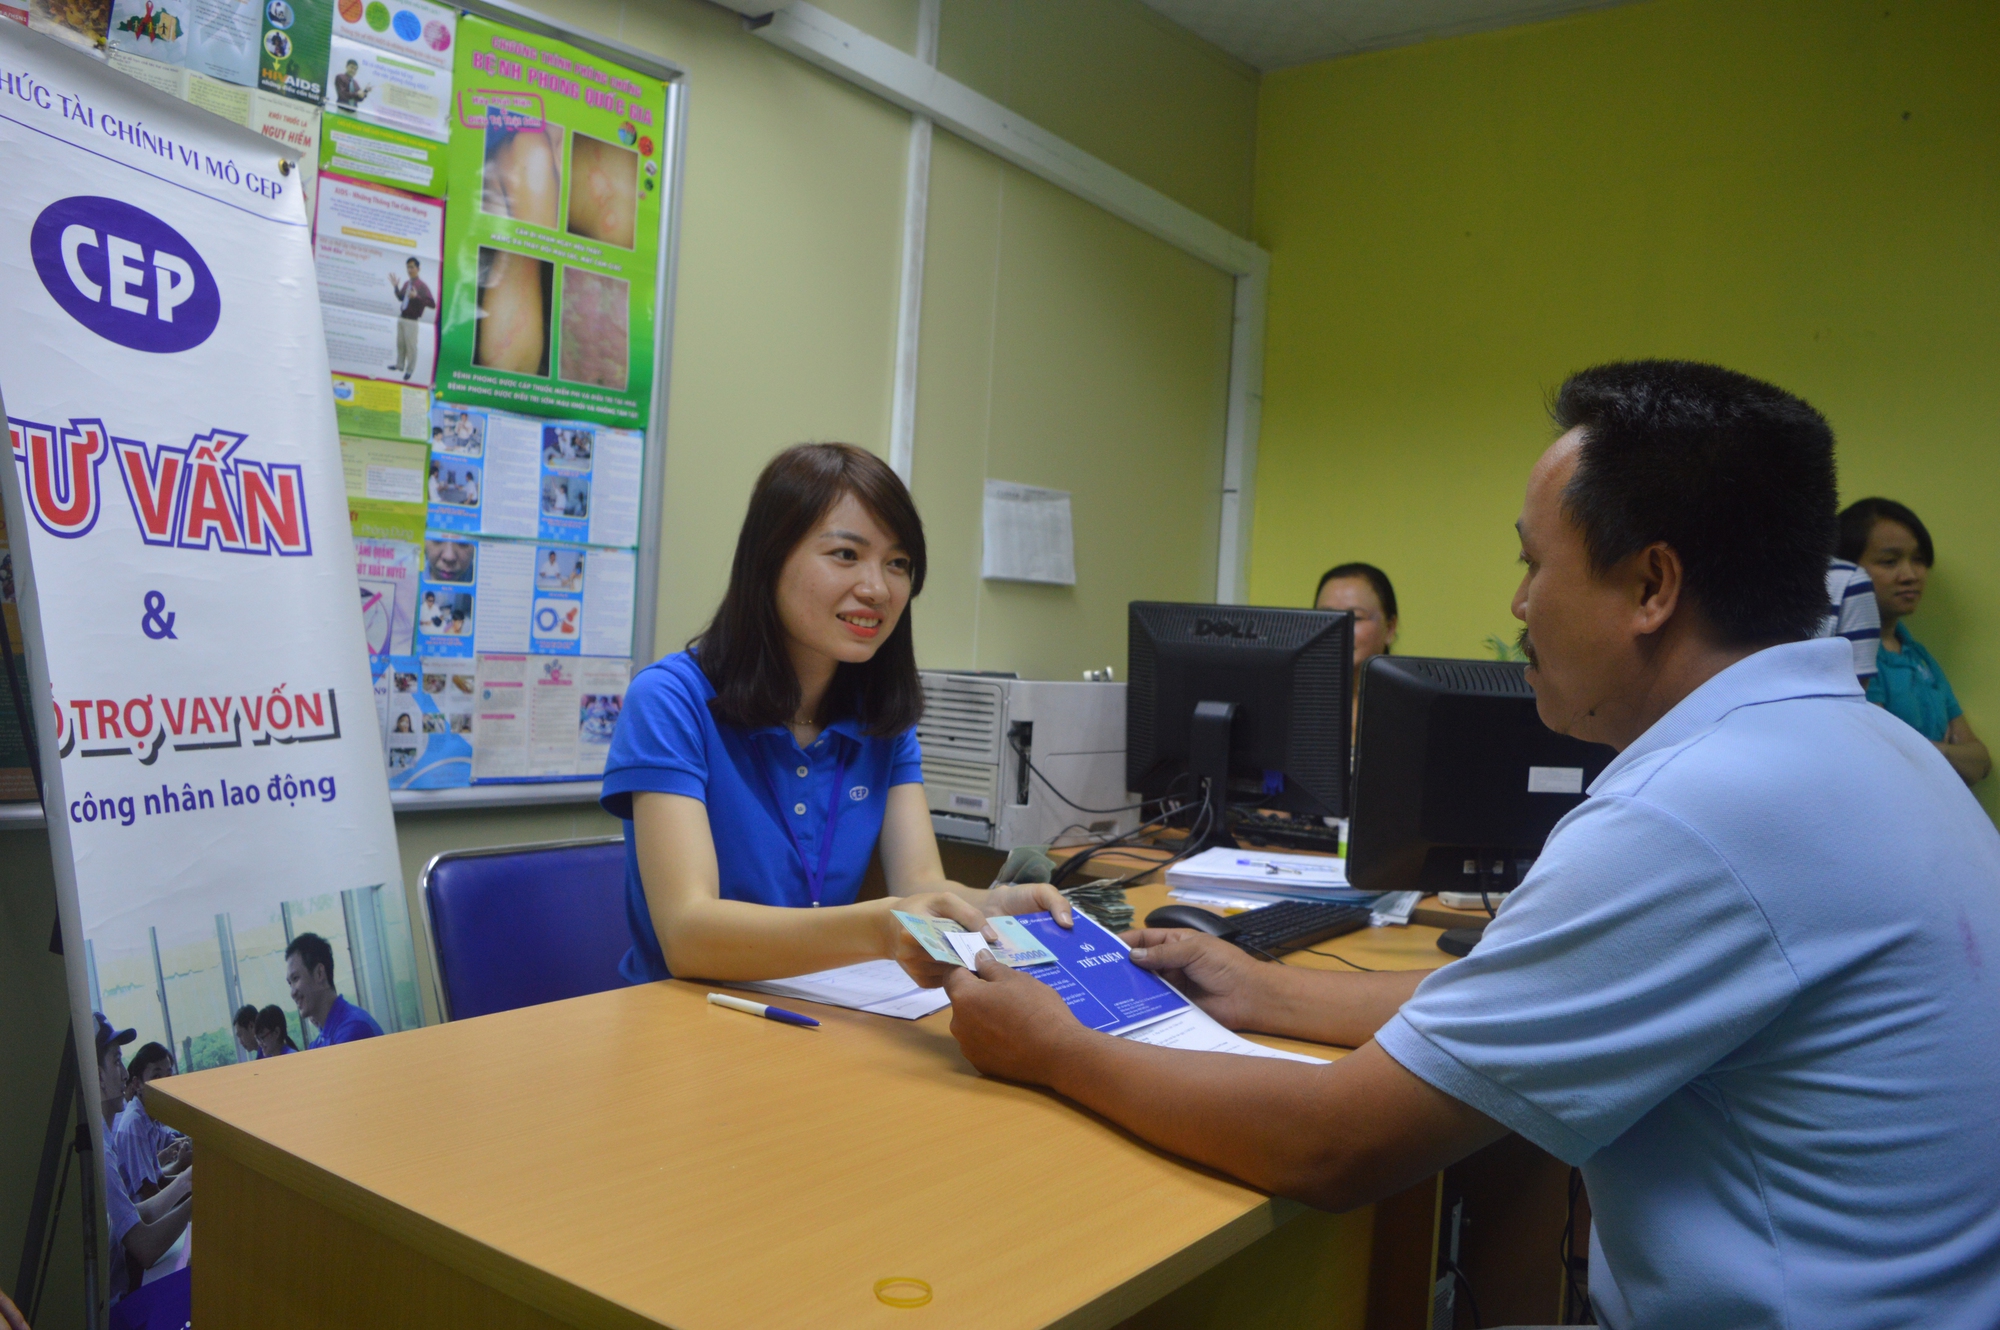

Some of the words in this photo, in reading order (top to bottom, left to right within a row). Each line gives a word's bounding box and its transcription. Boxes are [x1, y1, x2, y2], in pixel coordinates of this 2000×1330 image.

[542, 50, 572, 72] TRÌNH
[472, 50, 522, 81] BỆNH
[528, 67, 580, 100] PHONG
[585, 87, 625, 116] QUỐC
[629, 103, 653, 126] GIA
[57, 94, 94, 128] TÀI
[101, 114, 173, 160] CHÍNH
[178, 145, 199, 170] VI
[206, 156, 240, 185] MÔ
[246, 172, 282, 200] CEP
[262, 124, 286, 140] NGUY
[288, 130, 312, 147] HIỂM
[61, 224, 195, 323] CEP
[110, 428, 312, 557] VẤN
[142, 590, 178, 640] &
[70, 694, 154, 750] TRỢ
[160, 696, 232, 735] VAY
[240, 683, 325, 732] VỐN
[70, 792, 136, 826] công
[144, 782, 214, 816] nhân
[220, 779, 260, 807] lao
[267, 773, 336, 808] động
[850, 788, 867, 800] CEP
[1008, 949, 1048, 962] 500000
[1077, 956, 1101, 968] TIẾT
[1098, 951, 1124, 964] KIỆM
